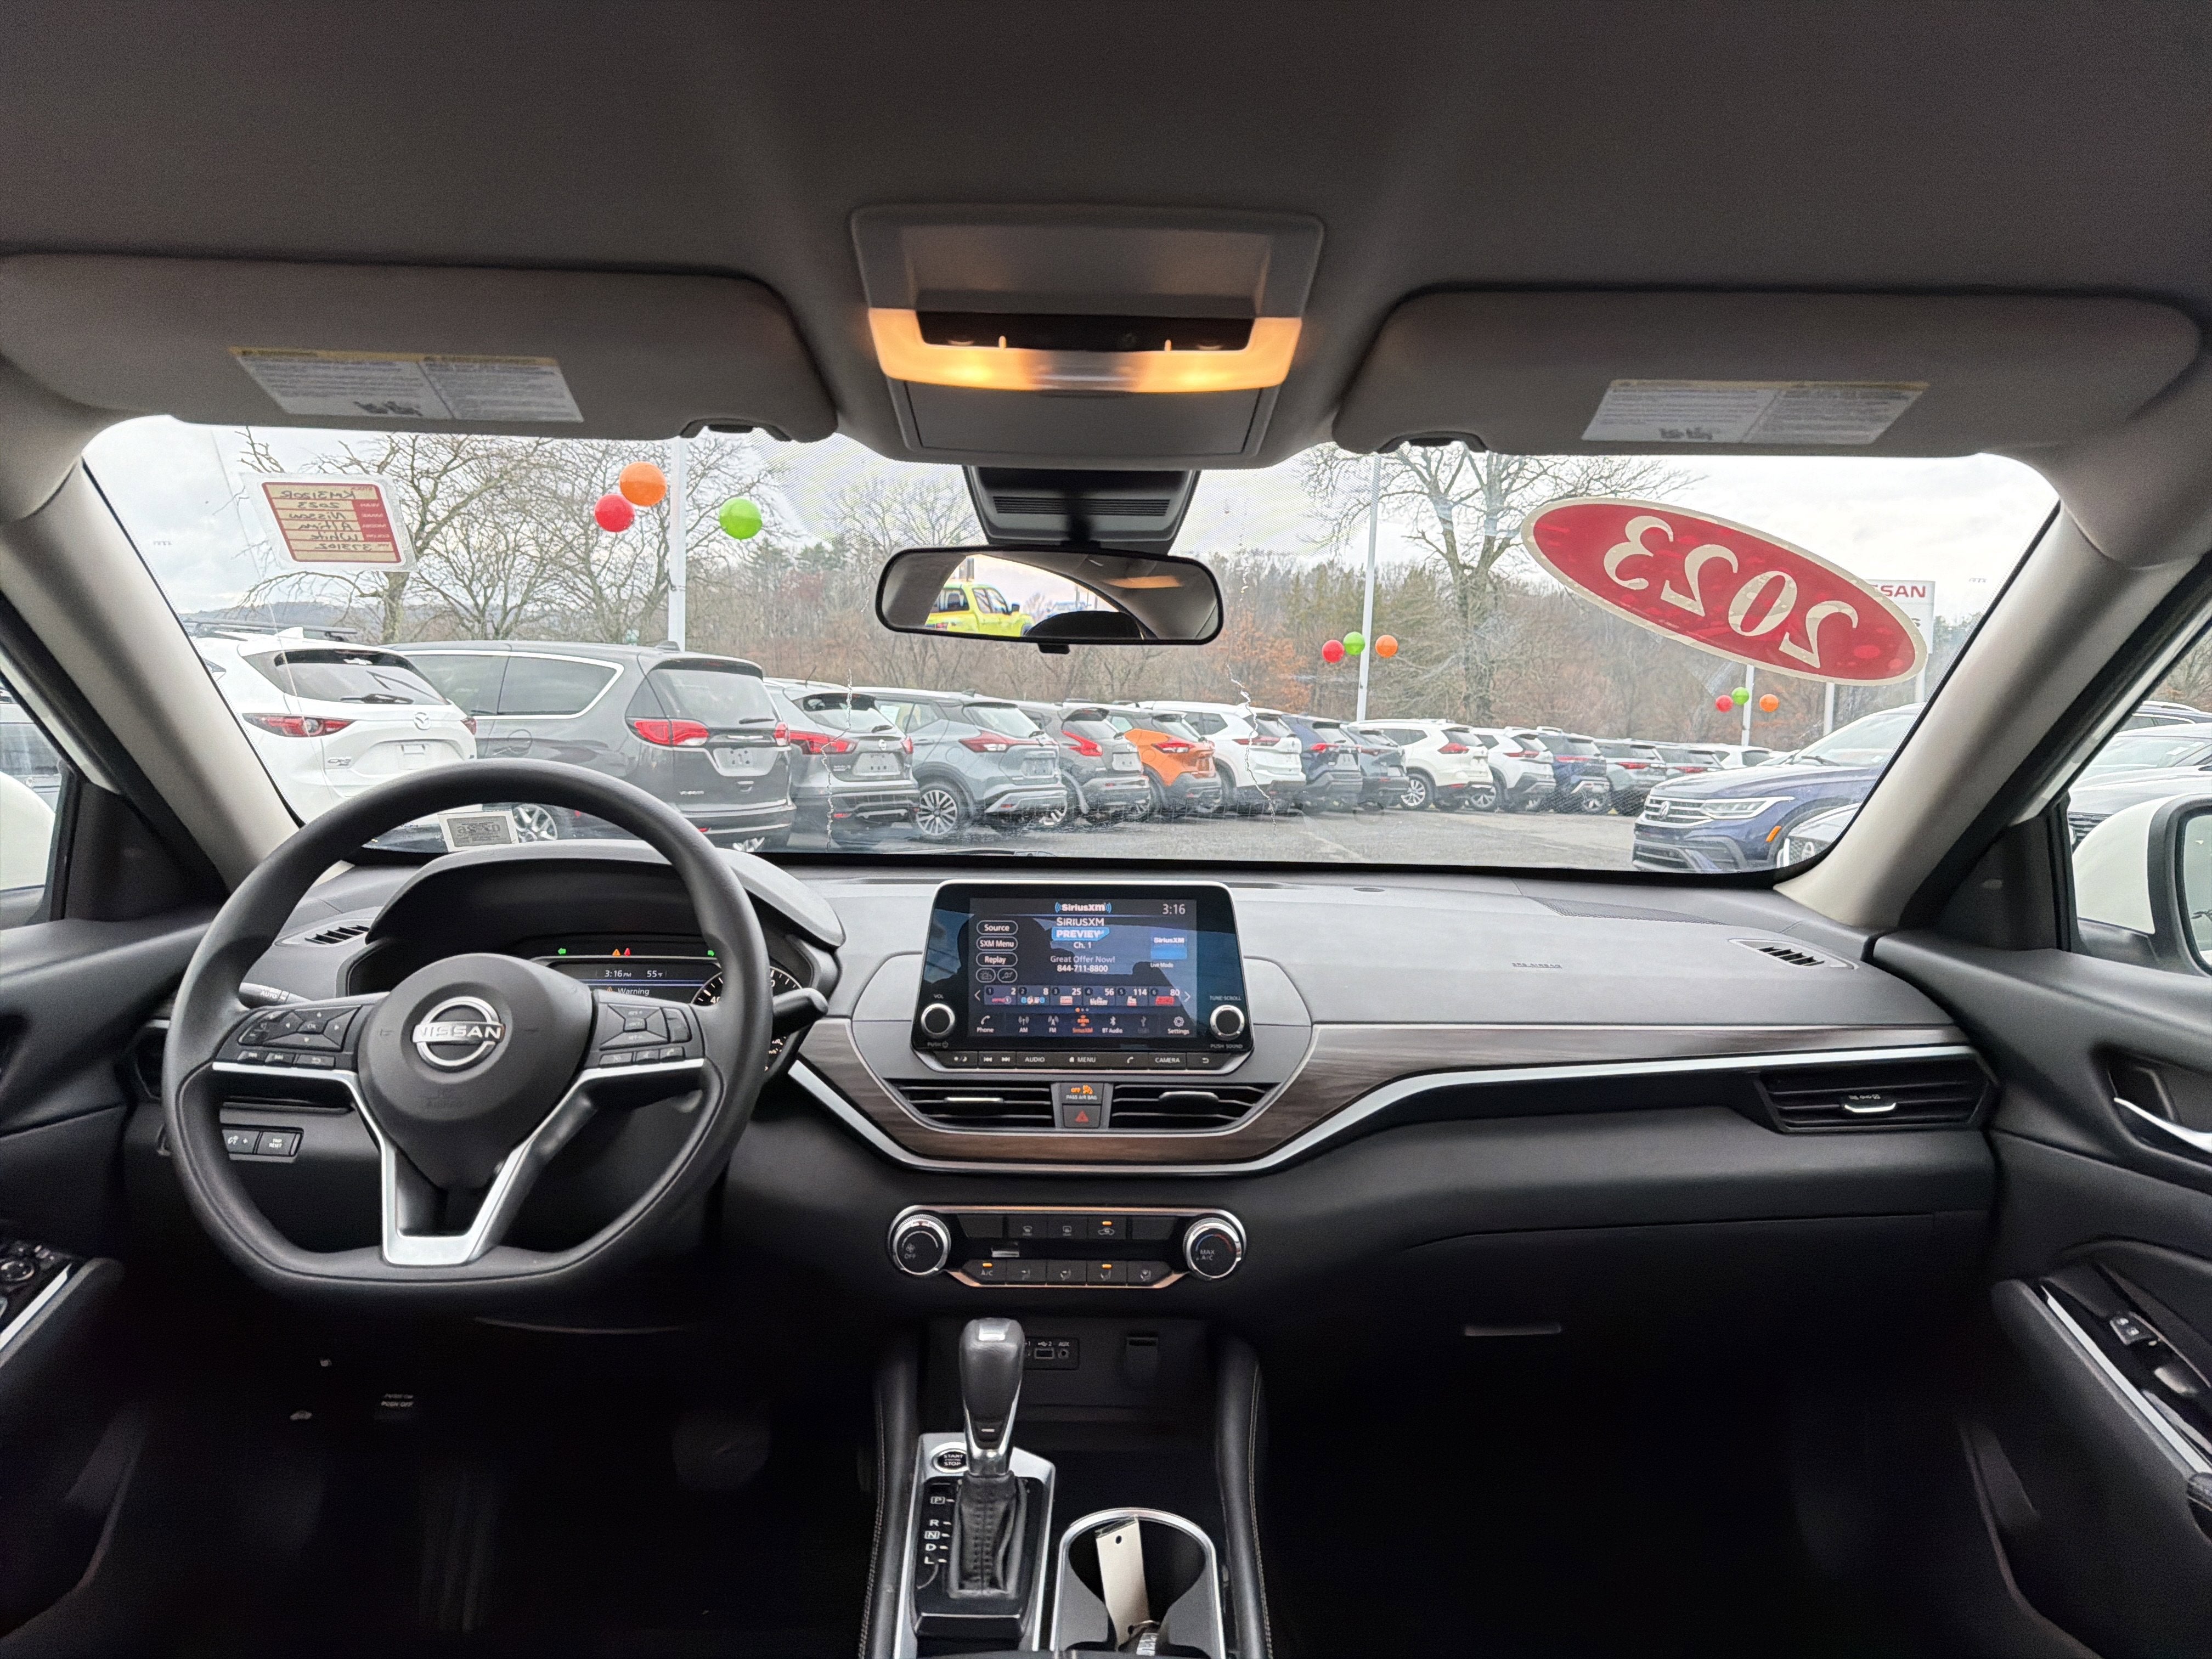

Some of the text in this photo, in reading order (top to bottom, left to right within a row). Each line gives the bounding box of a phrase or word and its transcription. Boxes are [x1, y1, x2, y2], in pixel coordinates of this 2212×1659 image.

[1872, 585, 1926, 598] SAN
[1162, 904, 1186, 915] 3:16
[1057, 917, 1104, 926] SIRIUSXM
[1056, 930, 1104, 938] PREVIEW
[985, 956, 1006, 964] Replay
[260, 990, 278, 999] AUTO
[417, 1025, 501, 1039] NISSAN
[926, 1543, 936, 1551] D
[924, 1556, 934, 1565] L
